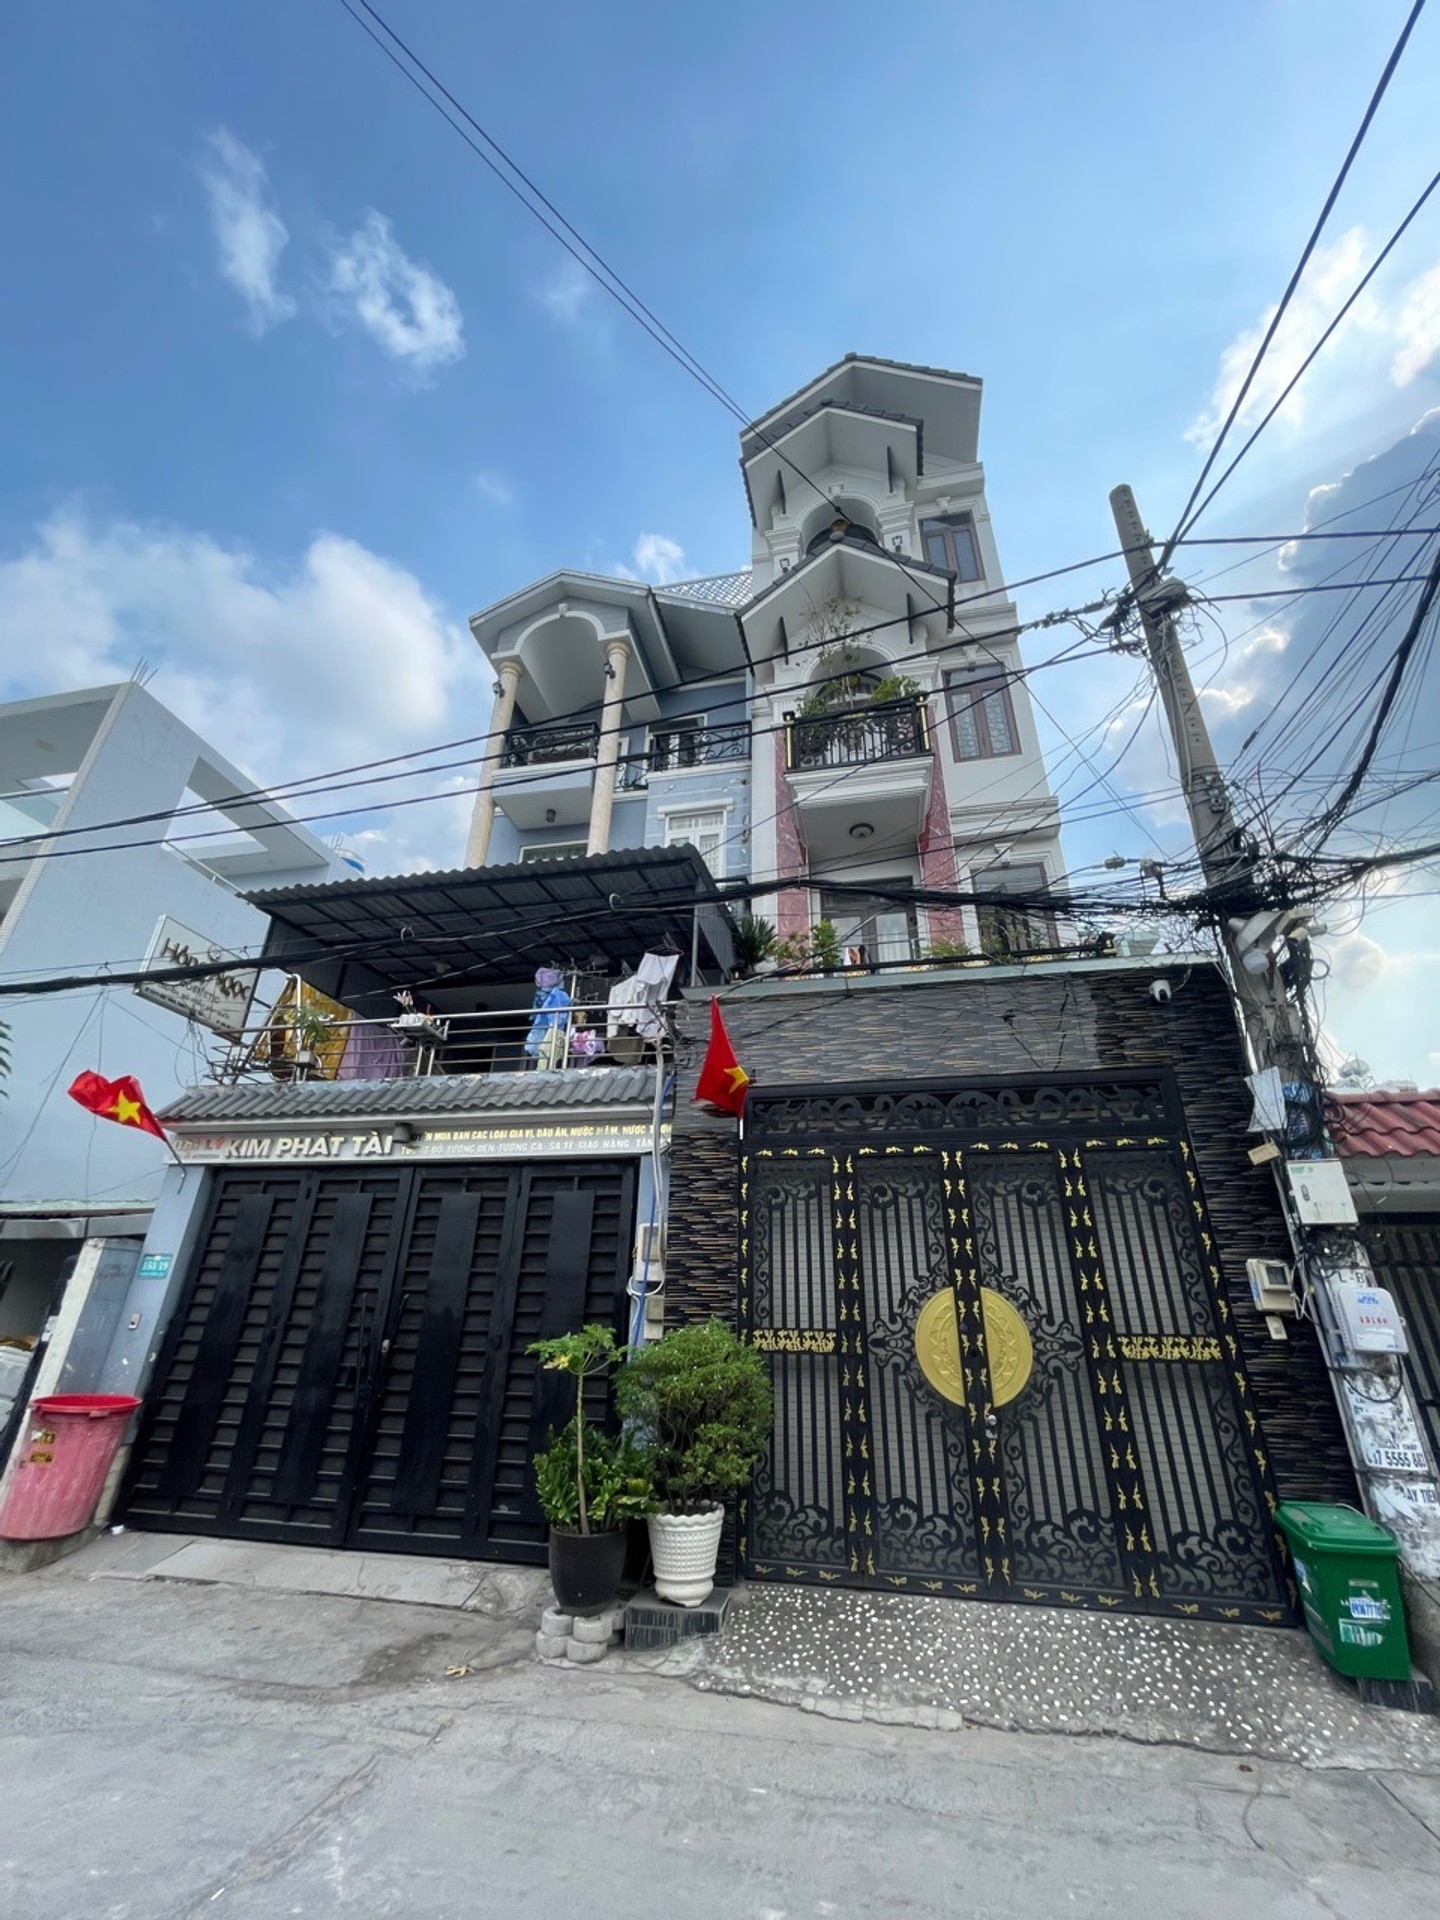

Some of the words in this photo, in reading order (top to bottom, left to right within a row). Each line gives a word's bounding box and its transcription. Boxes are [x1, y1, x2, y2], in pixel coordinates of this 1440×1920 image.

[225, 1138, 271, 1158] KIM
[277, 1131, 345, 1156] PHÁT
[352, 1131, 393, 1155] TÀI
[1384, 1450, 1411, 1468] 5555
